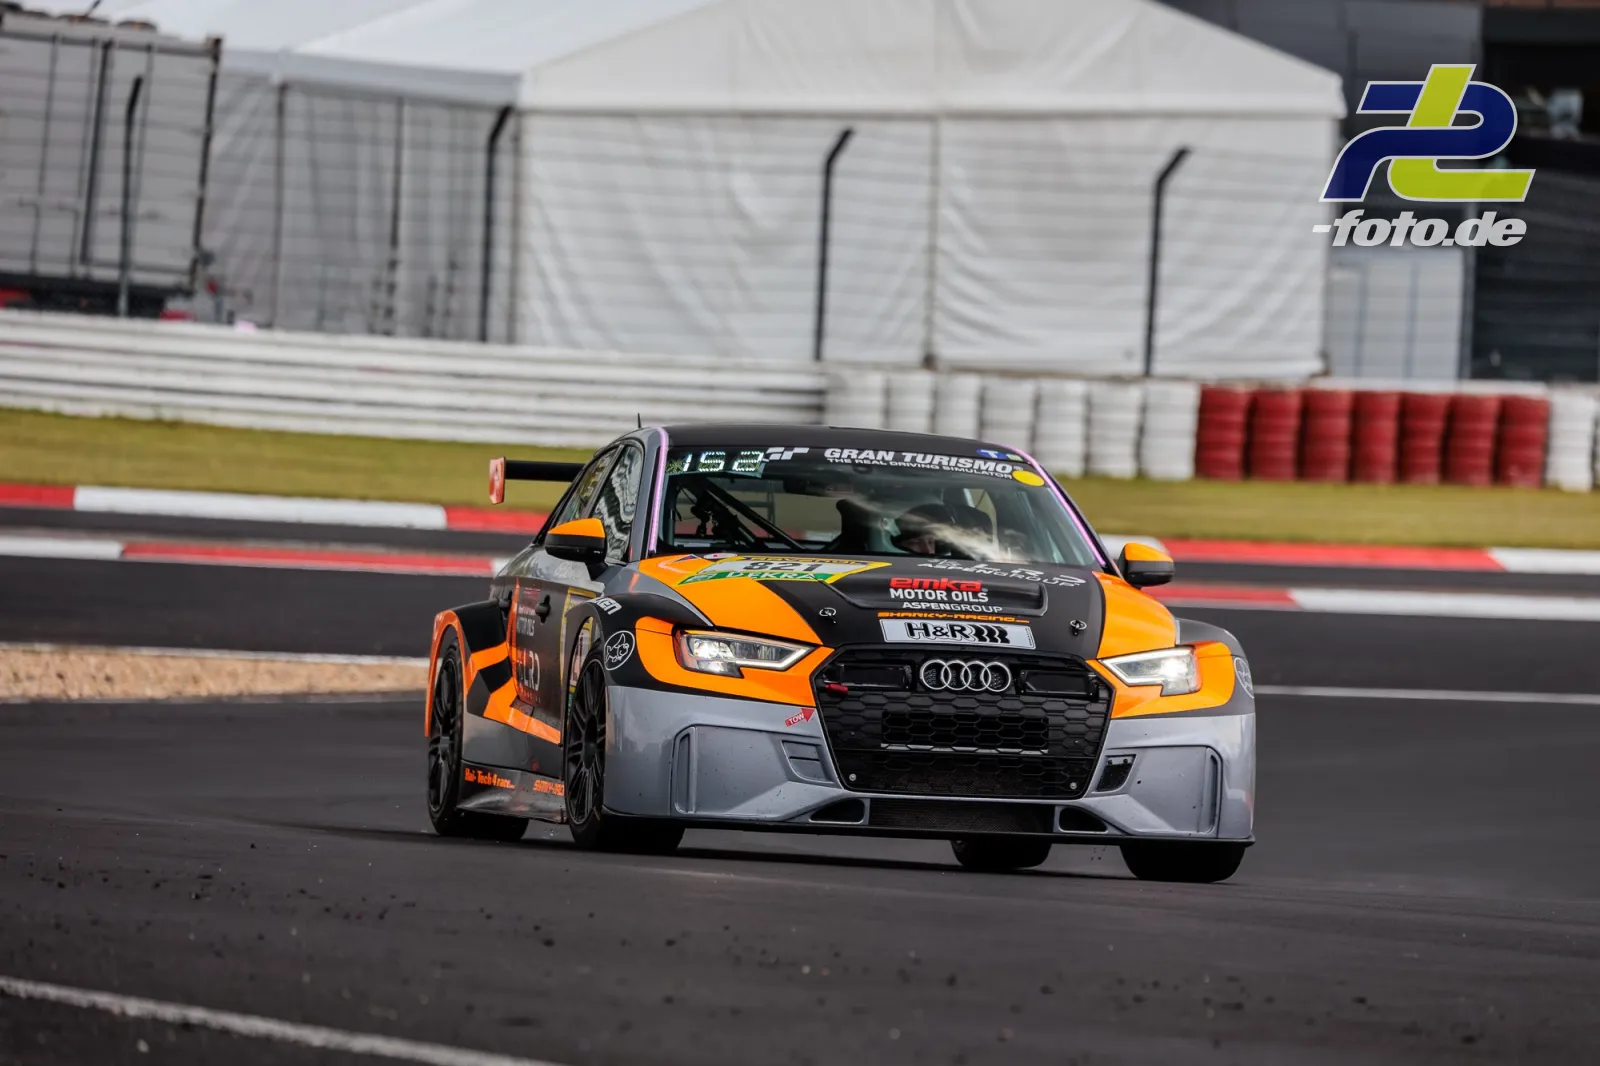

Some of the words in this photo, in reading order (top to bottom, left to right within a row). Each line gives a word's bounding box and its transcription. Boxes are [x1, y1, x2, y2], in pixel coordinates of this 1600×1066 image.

[823, 447, 895, 463] GRAN
[901, 451, 1014, 474] TURISMO
[855, 458, 888, 467] REAL
[890, 460, 940, 470] DRIVING
[942, 465, 1013, 480] SIMULATOR
[743, 561, 824, 572] 821
[726, 571, 814, 580] DEKRA
[889, 577, 983, 592] emka
[889, 588, 949, 601] MOTOR
[952, 590, 989, 603] OILS
[902, 601, 1003, 613] ASPENGROUP
[788, 712, 805, 725] TOW
